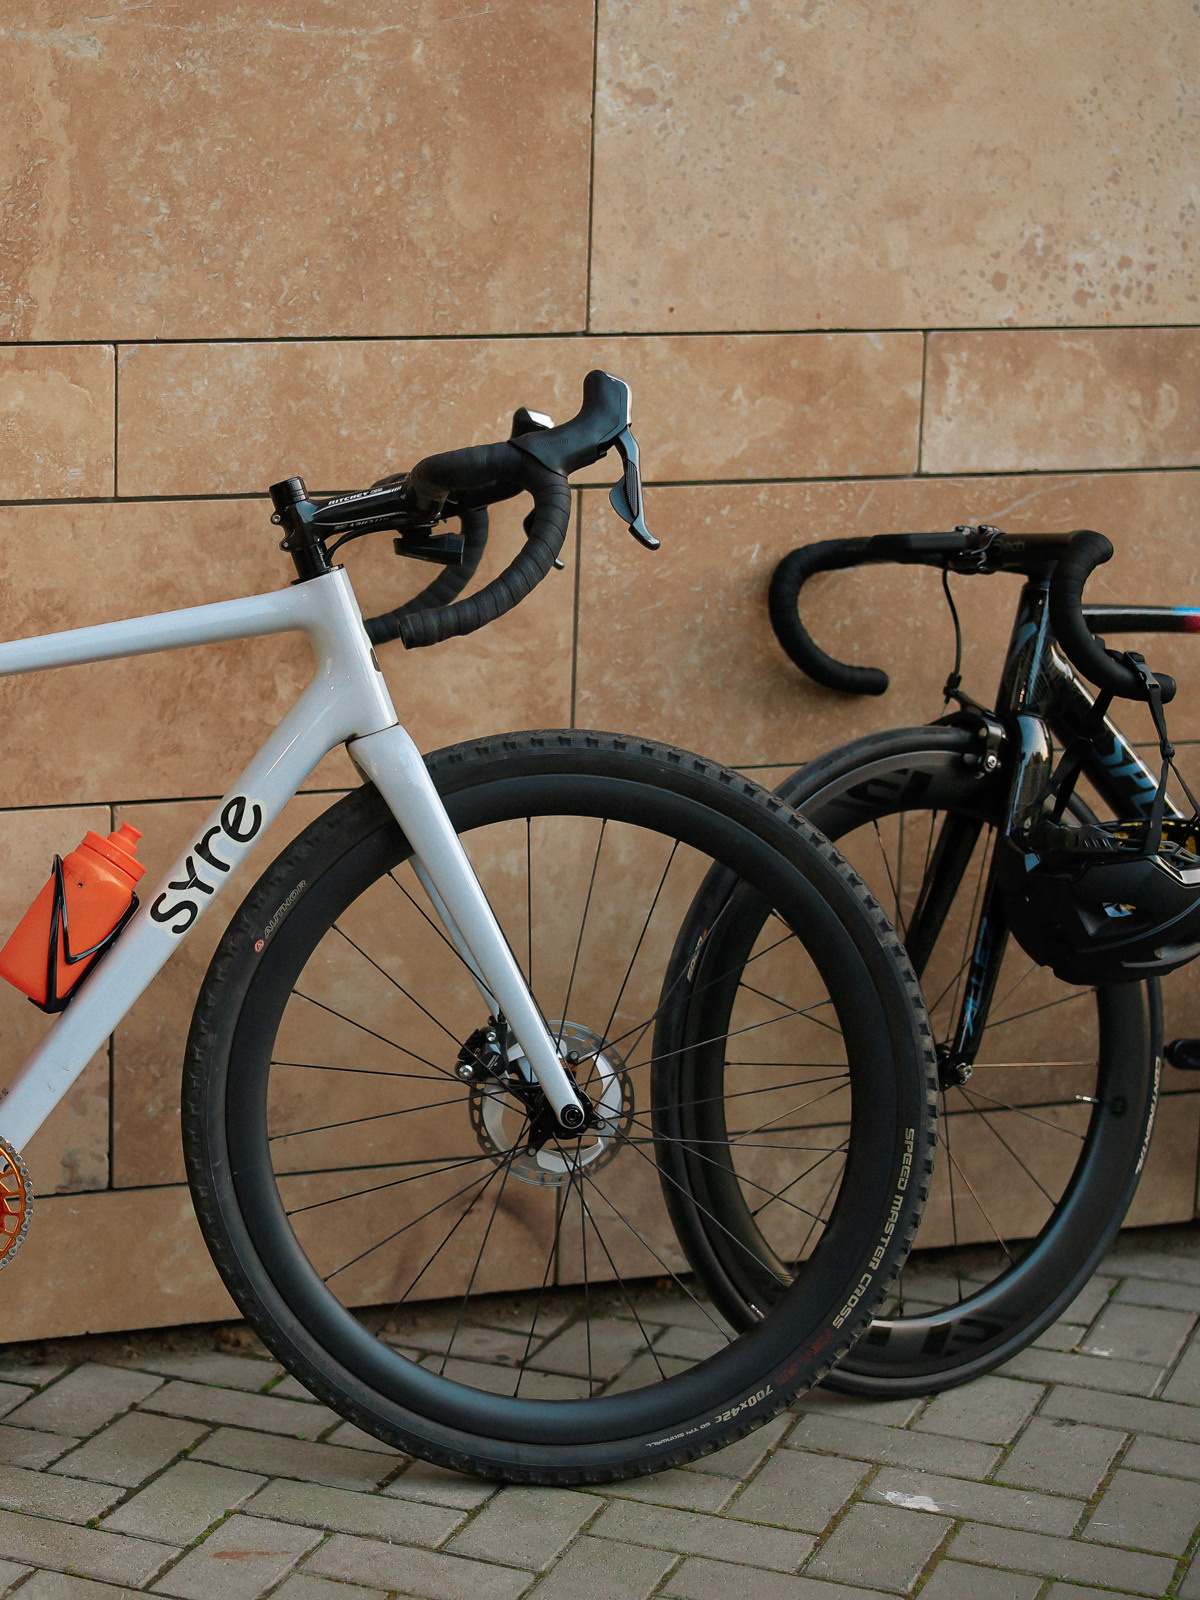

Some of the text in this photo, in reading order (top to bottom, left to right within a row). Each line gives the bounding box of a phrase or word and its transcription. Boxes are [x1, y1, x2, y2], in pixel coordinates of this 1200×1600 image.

[328, 492, 369, 506] RITCHEY
[264, 879, 307, 939] AUTHOR
[897, 1127, 915, 1191] SPEED
[868, 1194, 904, 1271] MASTER
[832, 1272, 873, 1329] CROSS
